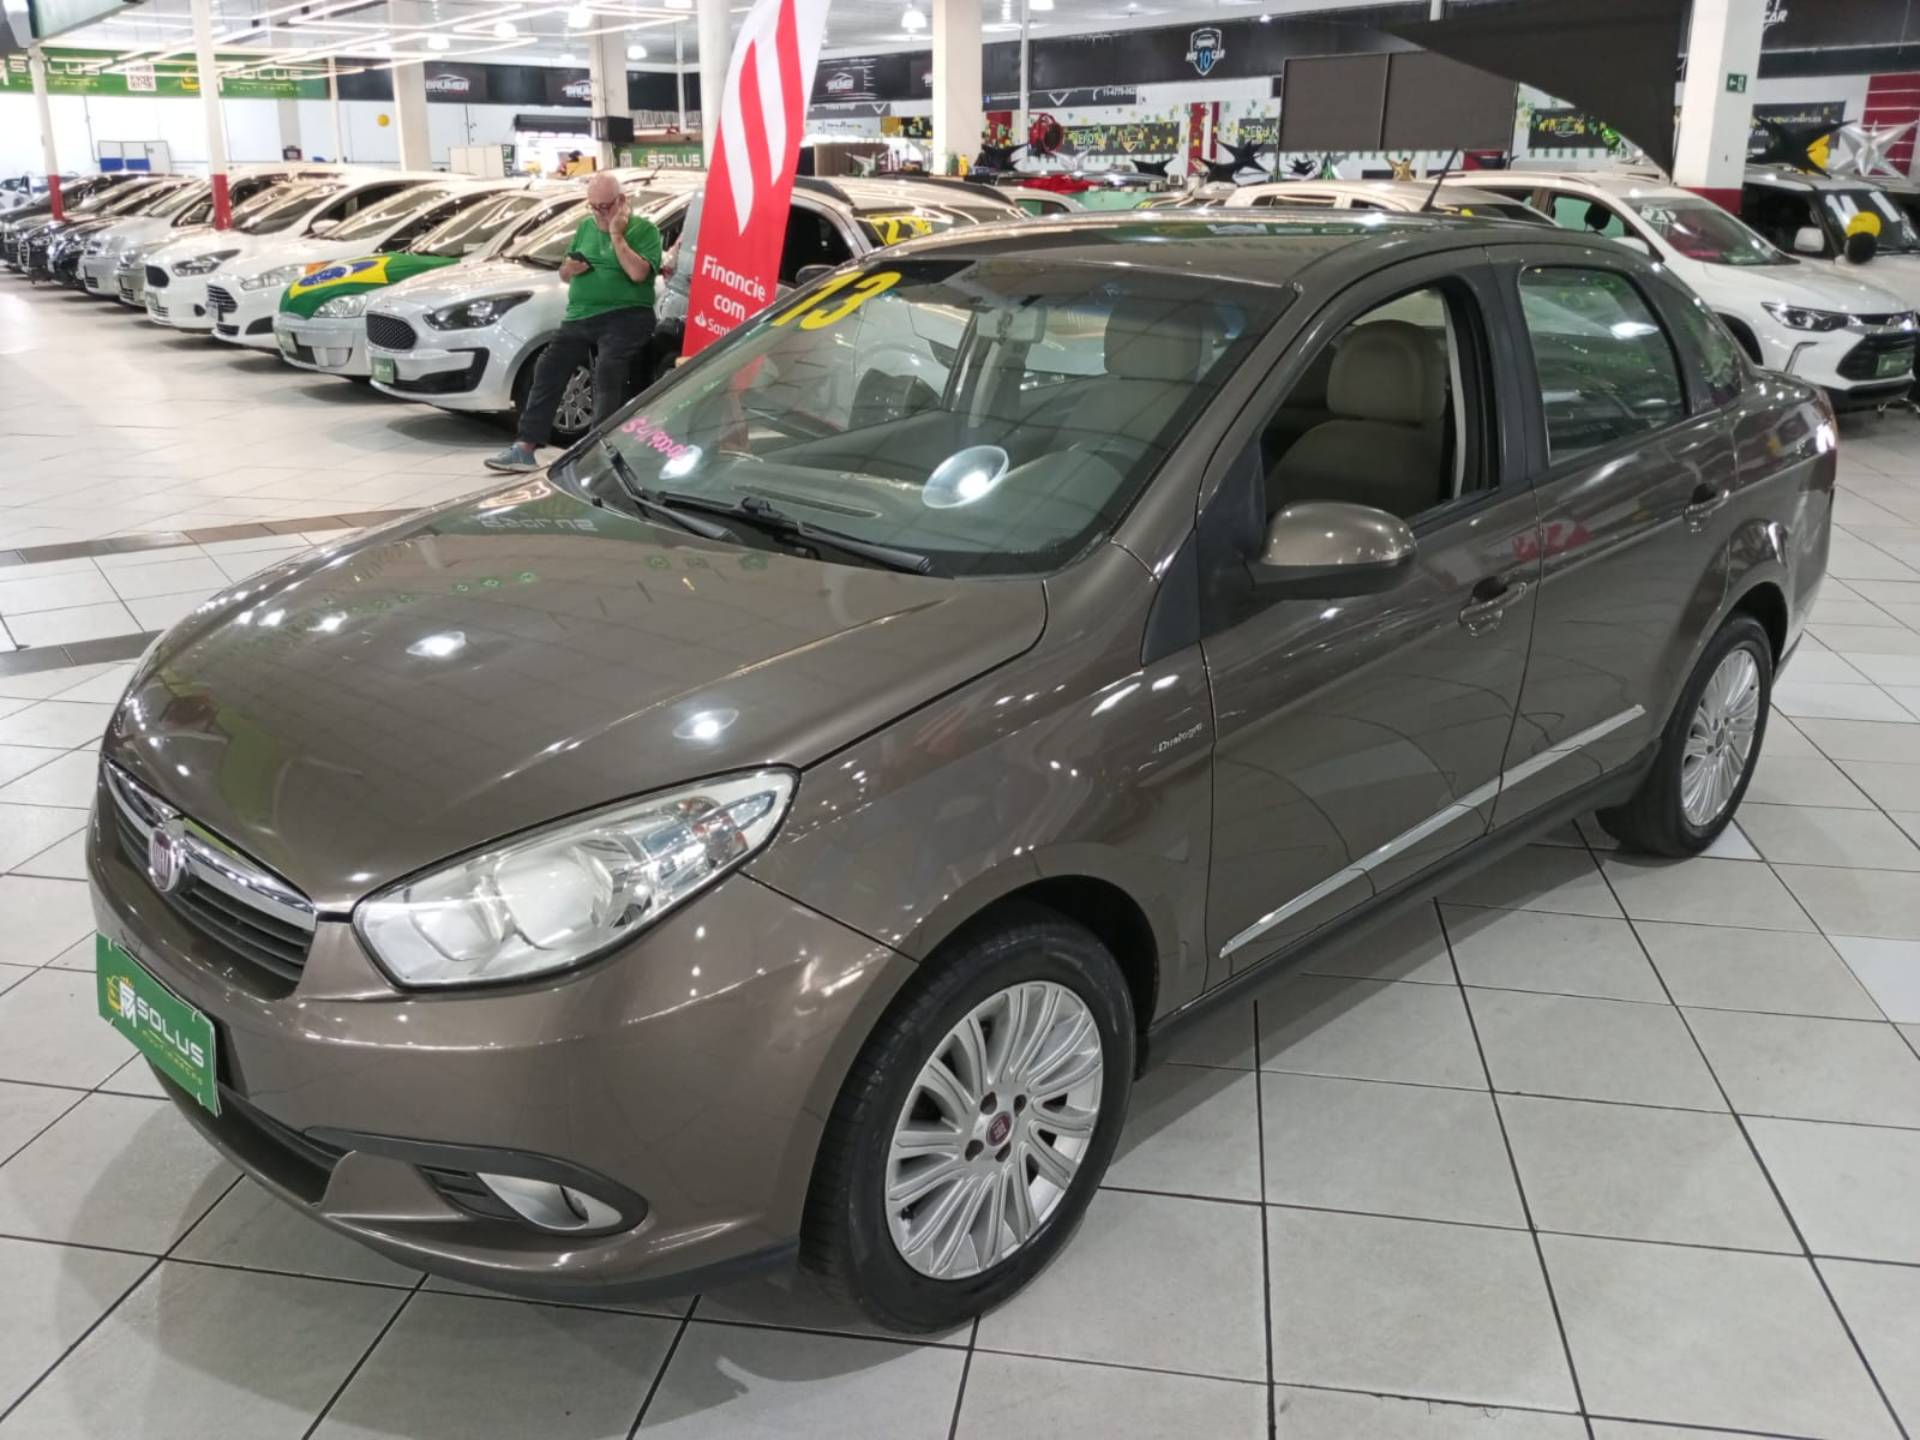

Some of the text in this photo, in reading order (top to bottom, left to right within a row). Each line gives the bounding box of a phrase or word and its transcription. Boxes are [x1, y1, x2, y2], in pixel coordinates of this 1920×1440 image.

[702, 254, 767, 302] Financie
[770, 270, 902, 330] 13
[707, 318, 732, 337] Sant
[714, 294, 746, 322] com
[136, 996, 205, 1068] SOLUS
